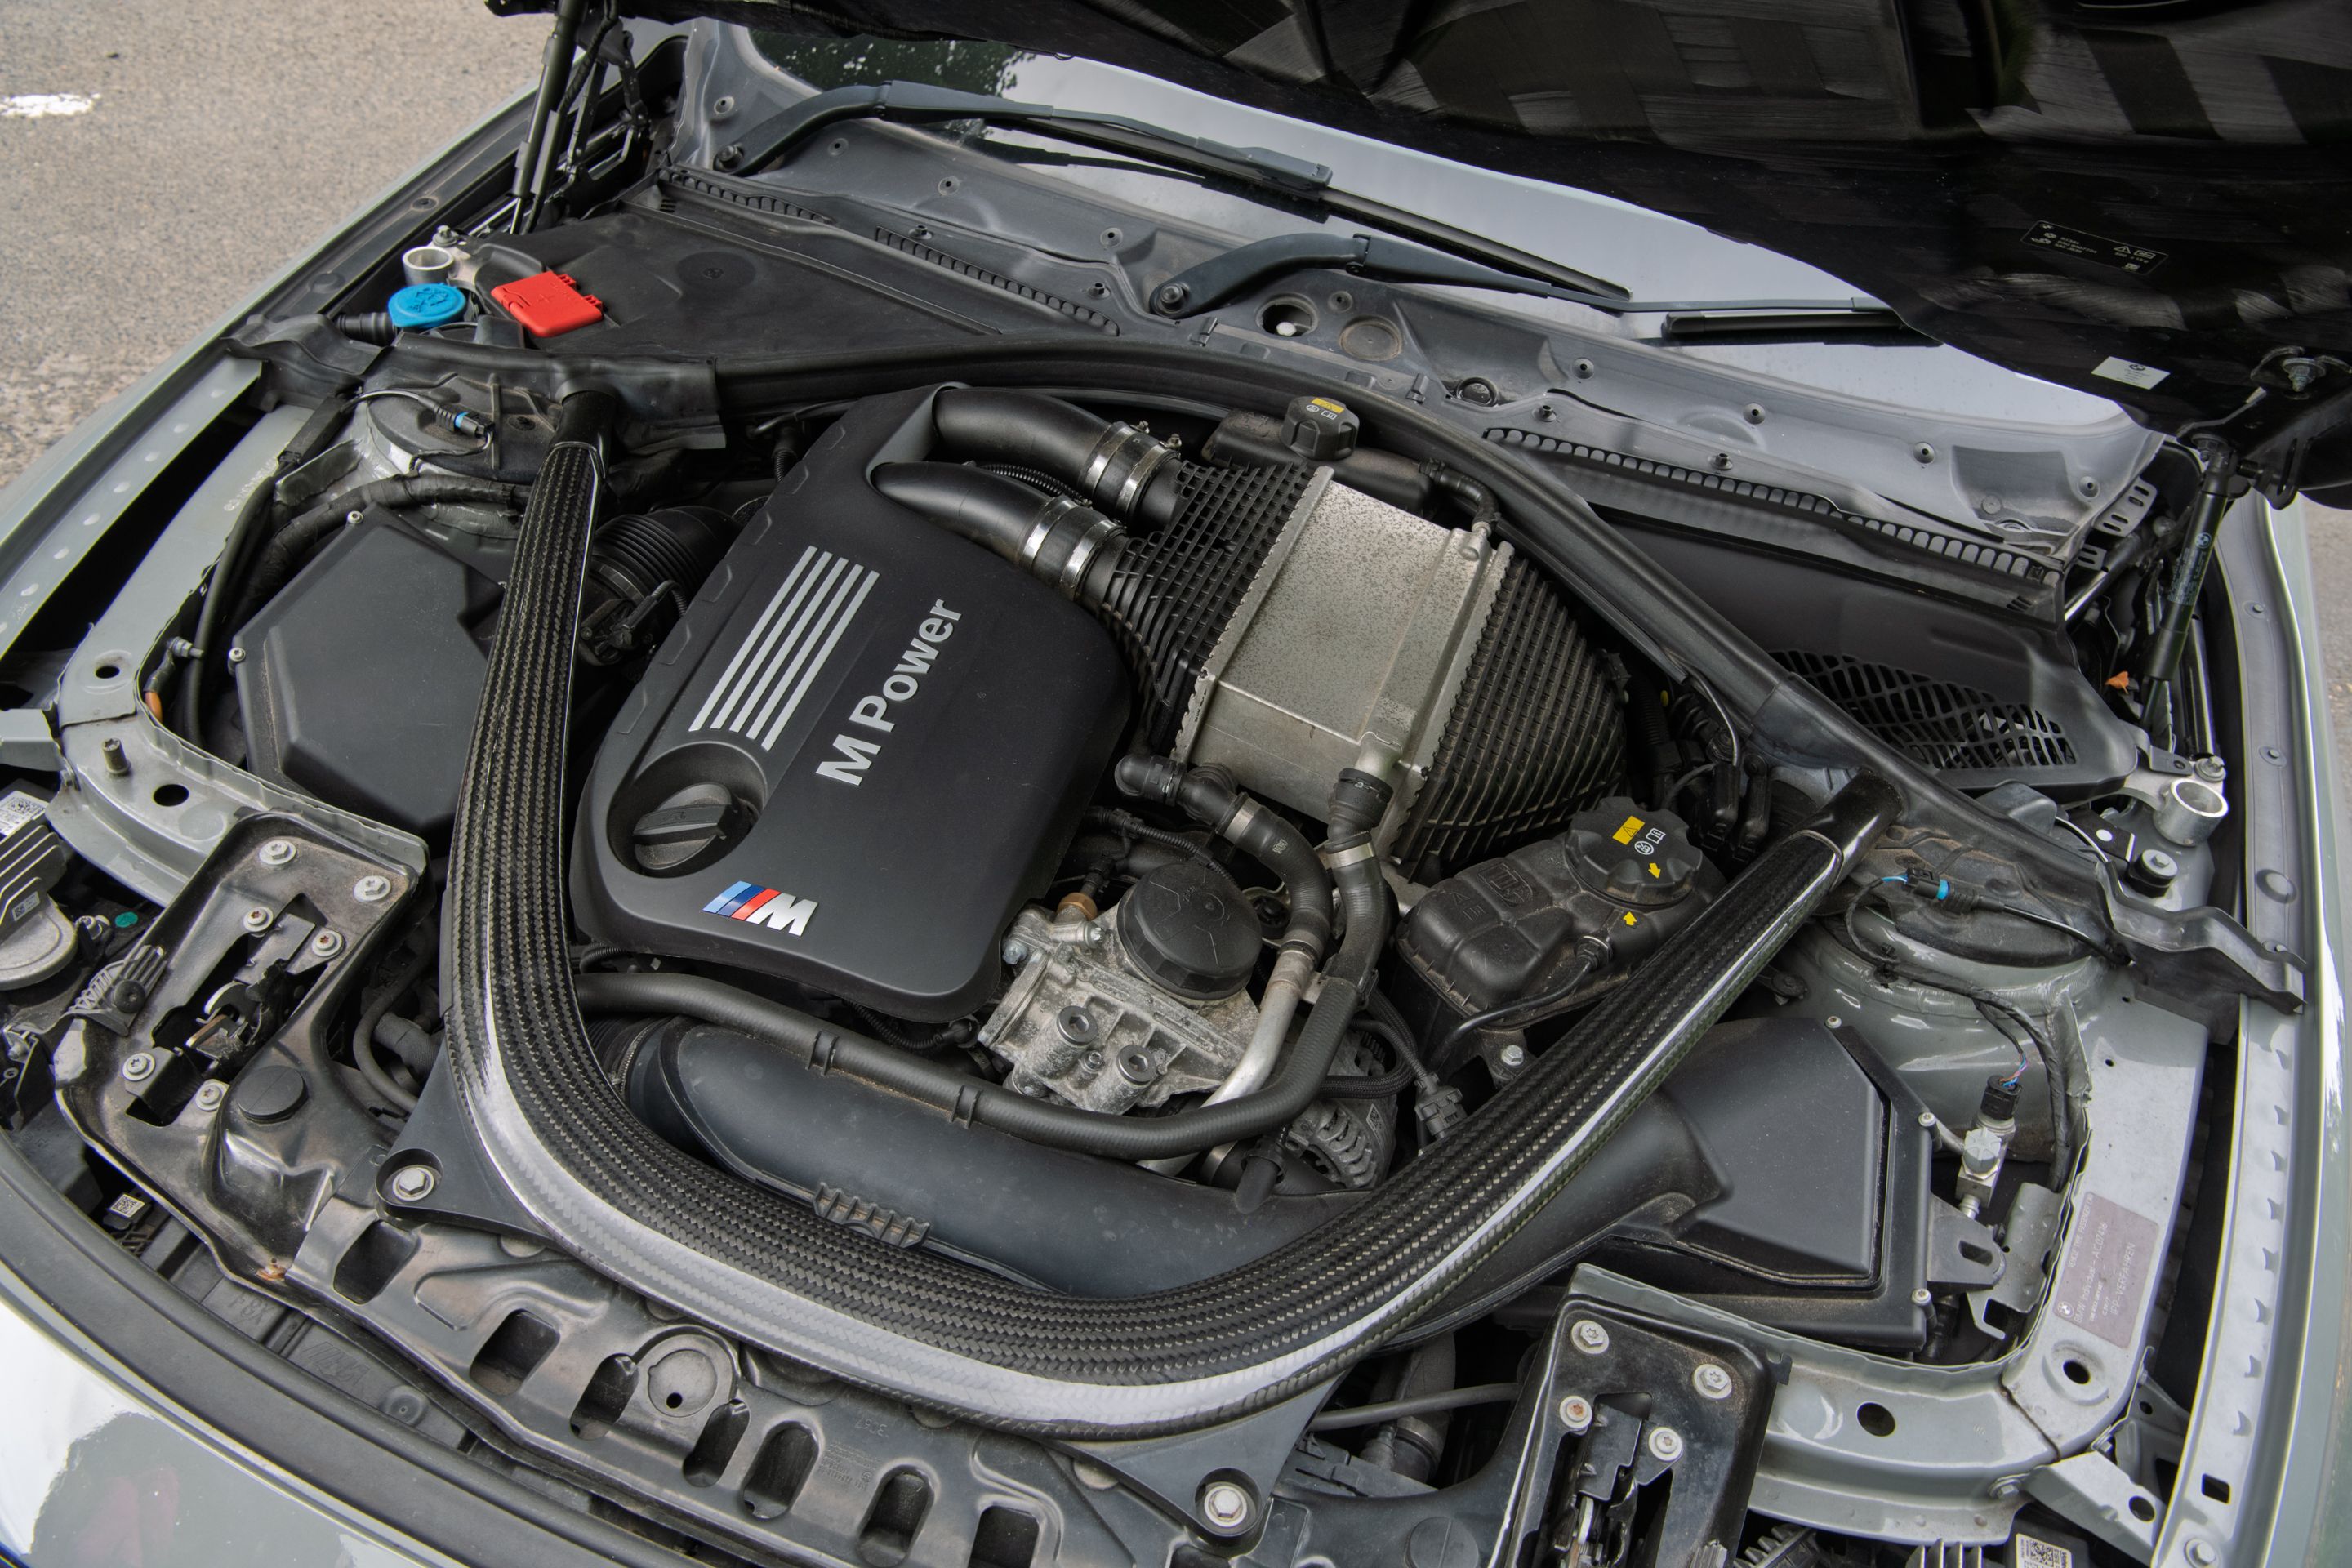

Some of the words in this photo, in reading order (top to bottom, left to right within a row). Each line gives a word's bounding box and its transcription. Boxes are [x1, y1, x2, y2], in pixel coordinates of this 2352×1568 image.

[816, 734, 881, 786] M
[849, 599, 962, 733] Power
[746, 893, 819, 936] M
[2073, 1299, 2086, 1323] BMW
